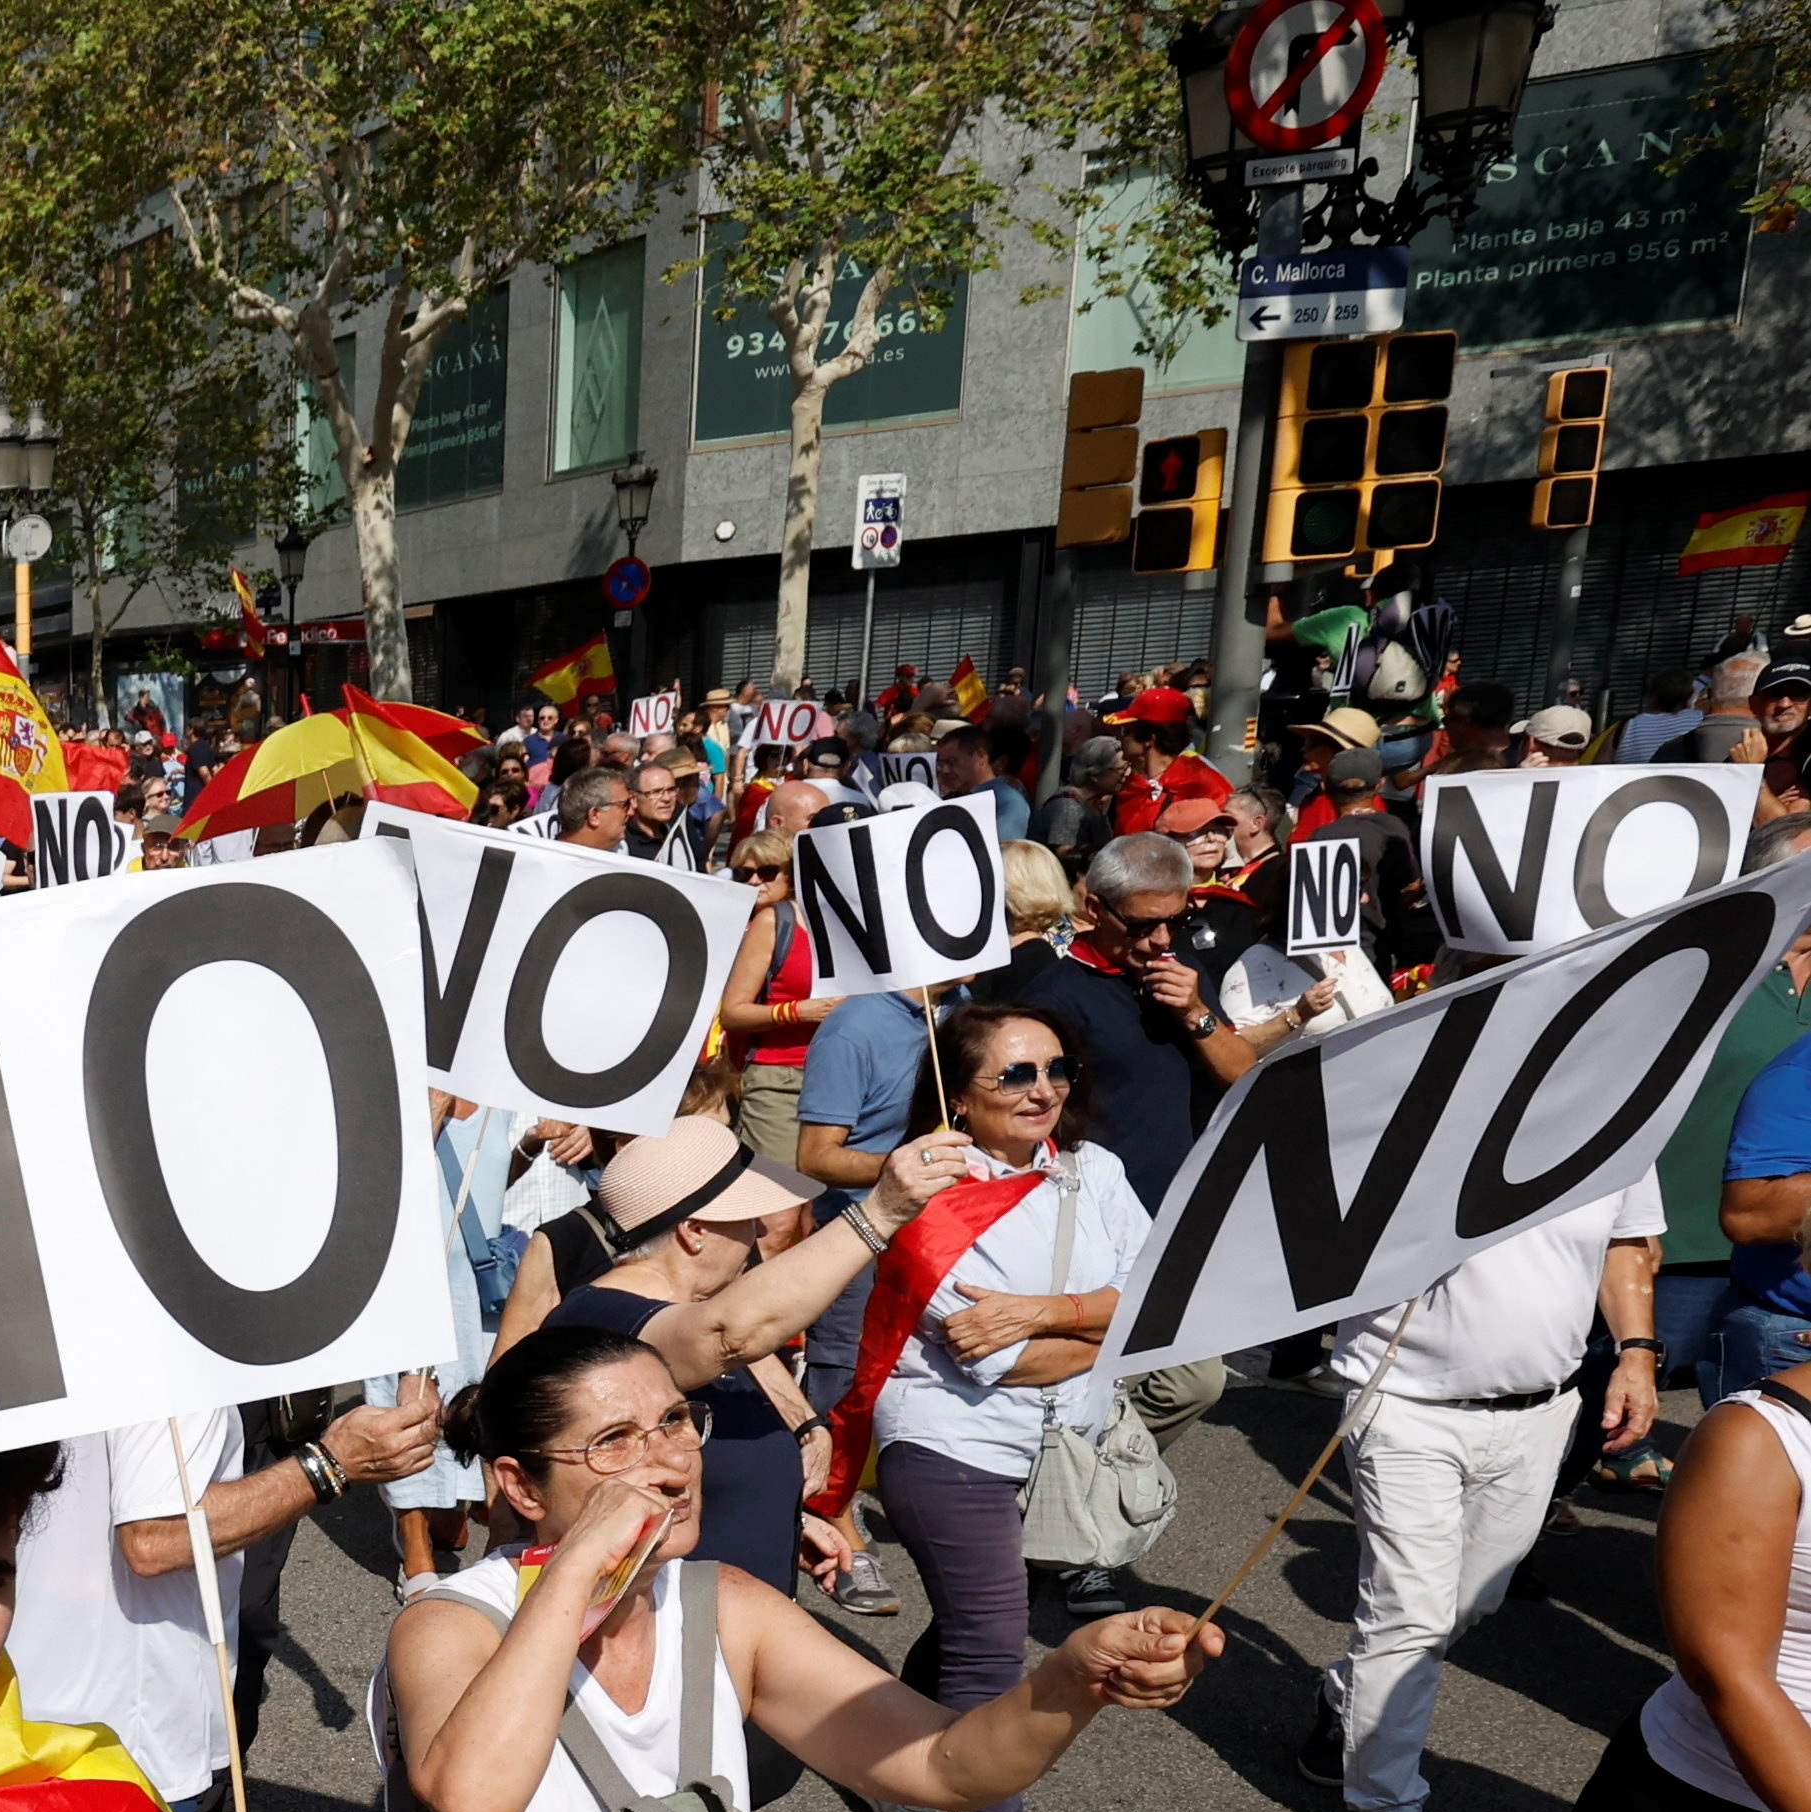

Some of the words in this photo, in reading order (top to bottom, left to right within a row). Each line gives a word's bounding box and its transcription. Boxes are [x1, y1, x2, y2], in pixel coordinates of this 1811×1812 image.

[1252, 164, 1296, 179] Excepte
[1453, 228, 1538, 254] Planta
[1546, 218, 1604, 241] baja
[1615, 208, 1651, 231] 43
[1251, 264, 1268, 285] C.
[1275, 261, 1346, 283] Mallorca
[1416, 266, 1499, 290] Planta
[1508, 252, 1617, 283] primera
[1628, 238, 1680, 264] 956
[1294, 308, 1319, 323] 250
[1322, 305, 1331, 323] /
[1335, 304, 1359, 320] 259
[727, 331, 787, 359] 934
[631, 697, 671, 735] NO
[753, 702, 817, 742] NO
[882, 756, 933, 791] NO
[34, 796, 113, 889] NO
[1431, 775, 1731, 942] NO
[798, 805, 996, 978] NO
[1292, 843, 1357, 940] NO
[378, 822, 708, 1108] NO
[1121, 891, 1775, 1355] NO
